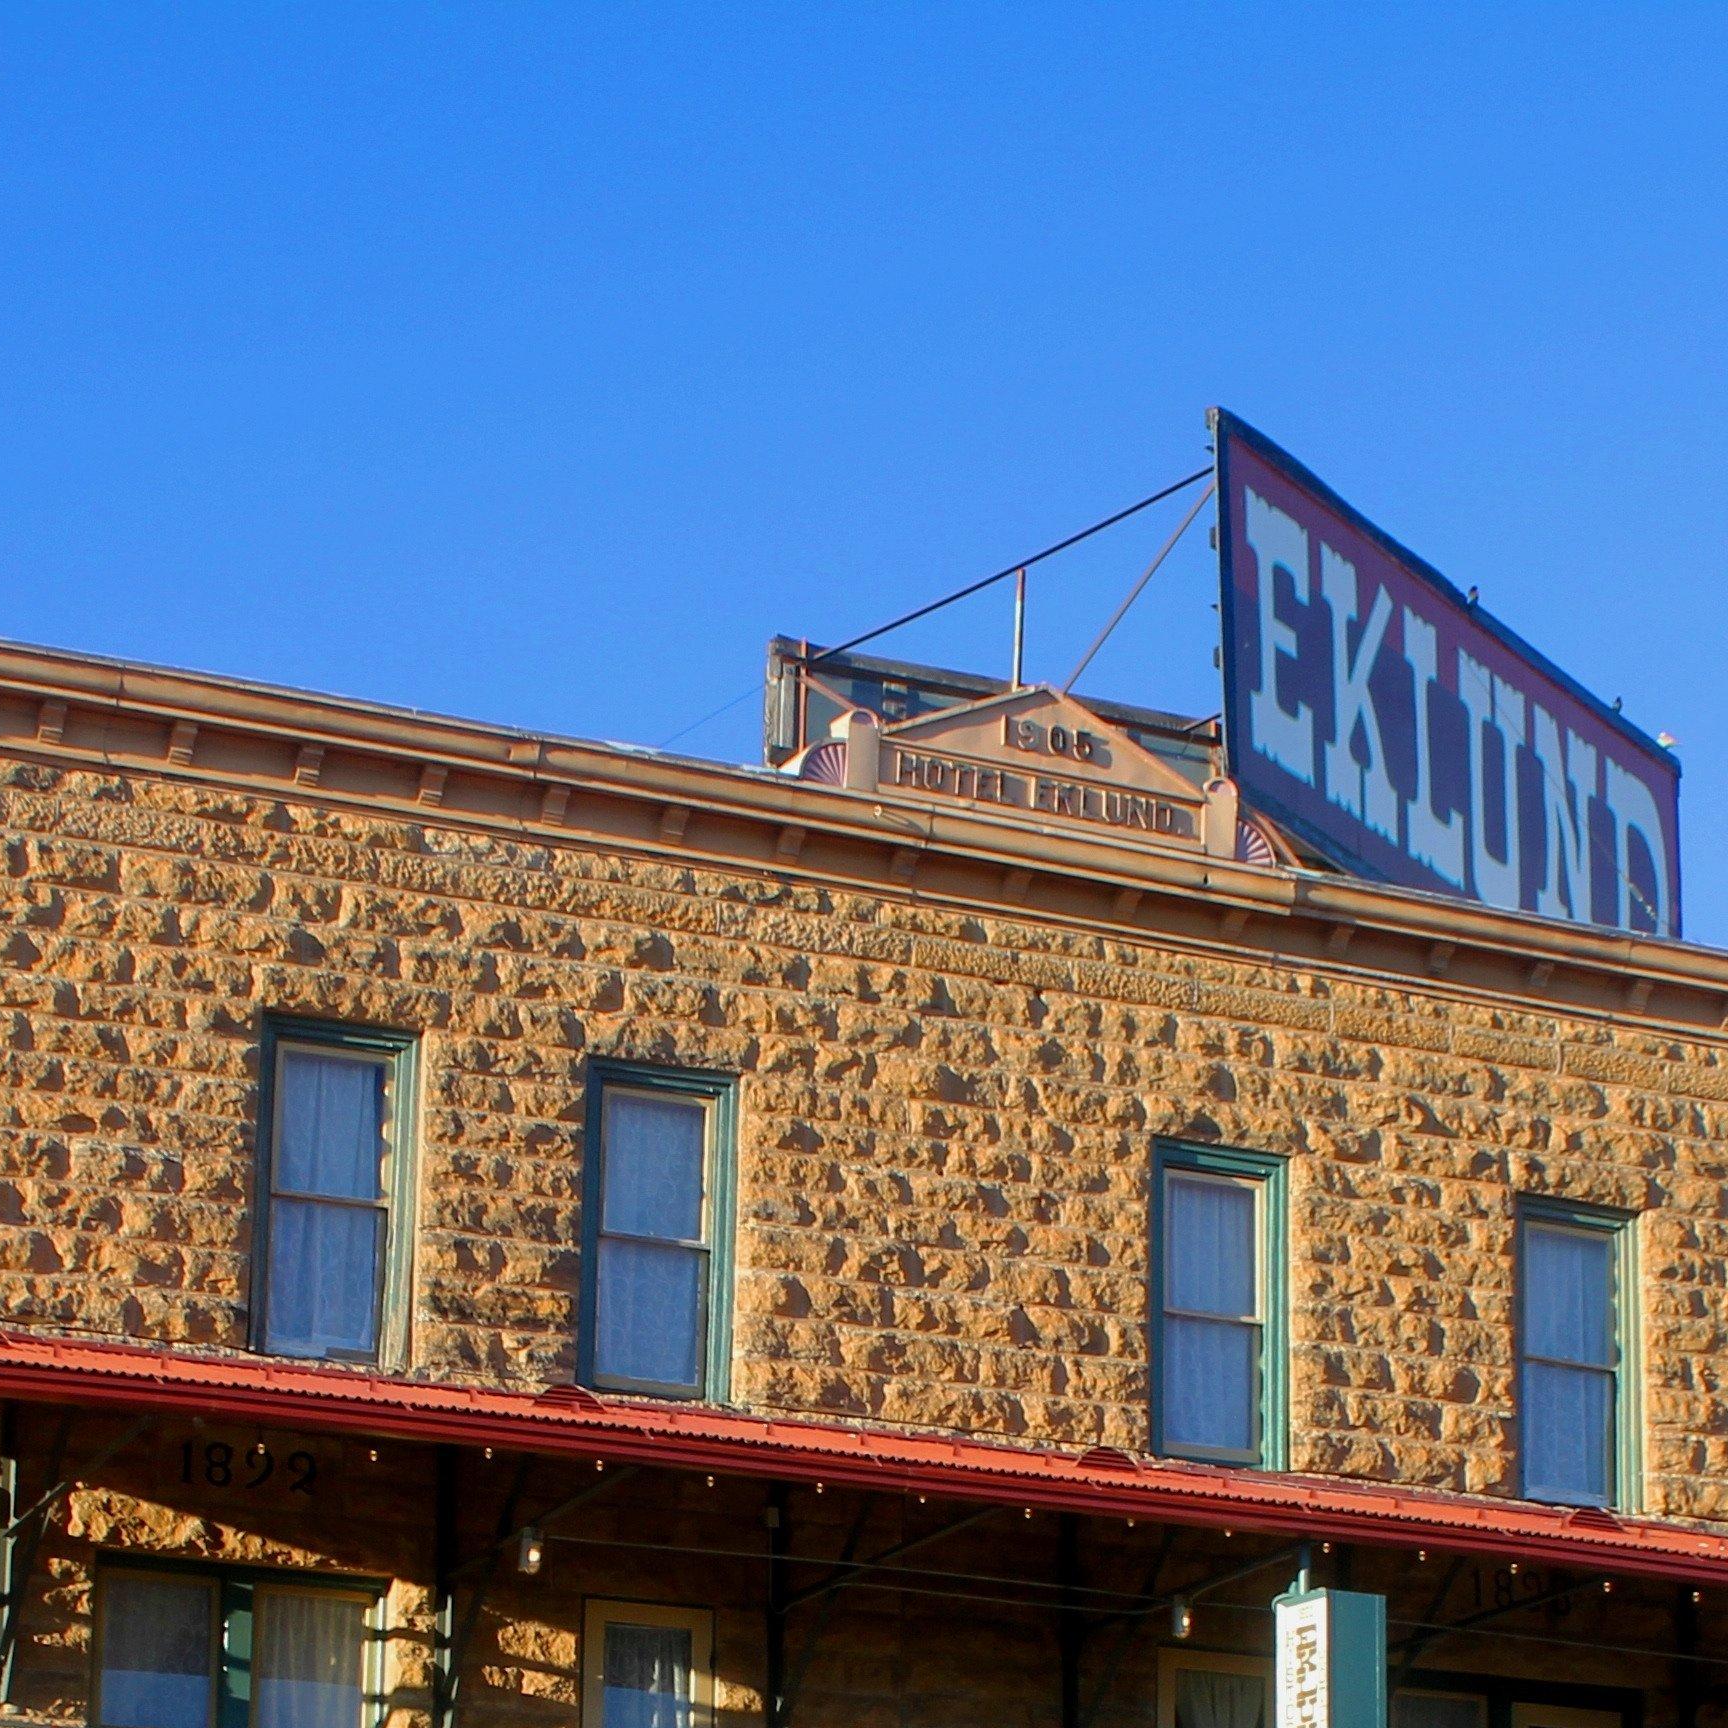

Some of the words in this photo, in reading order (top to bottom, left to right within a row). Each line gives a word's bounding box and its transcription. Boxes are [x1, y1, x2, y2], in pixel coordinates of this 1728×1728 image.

[999, 713, 1095, 763] 1905
[1244, 484, 1672, 938] EKLUND
[894, 749, 1003, 805] HOTEL
[179, 1439, 318, 1496] 1892
